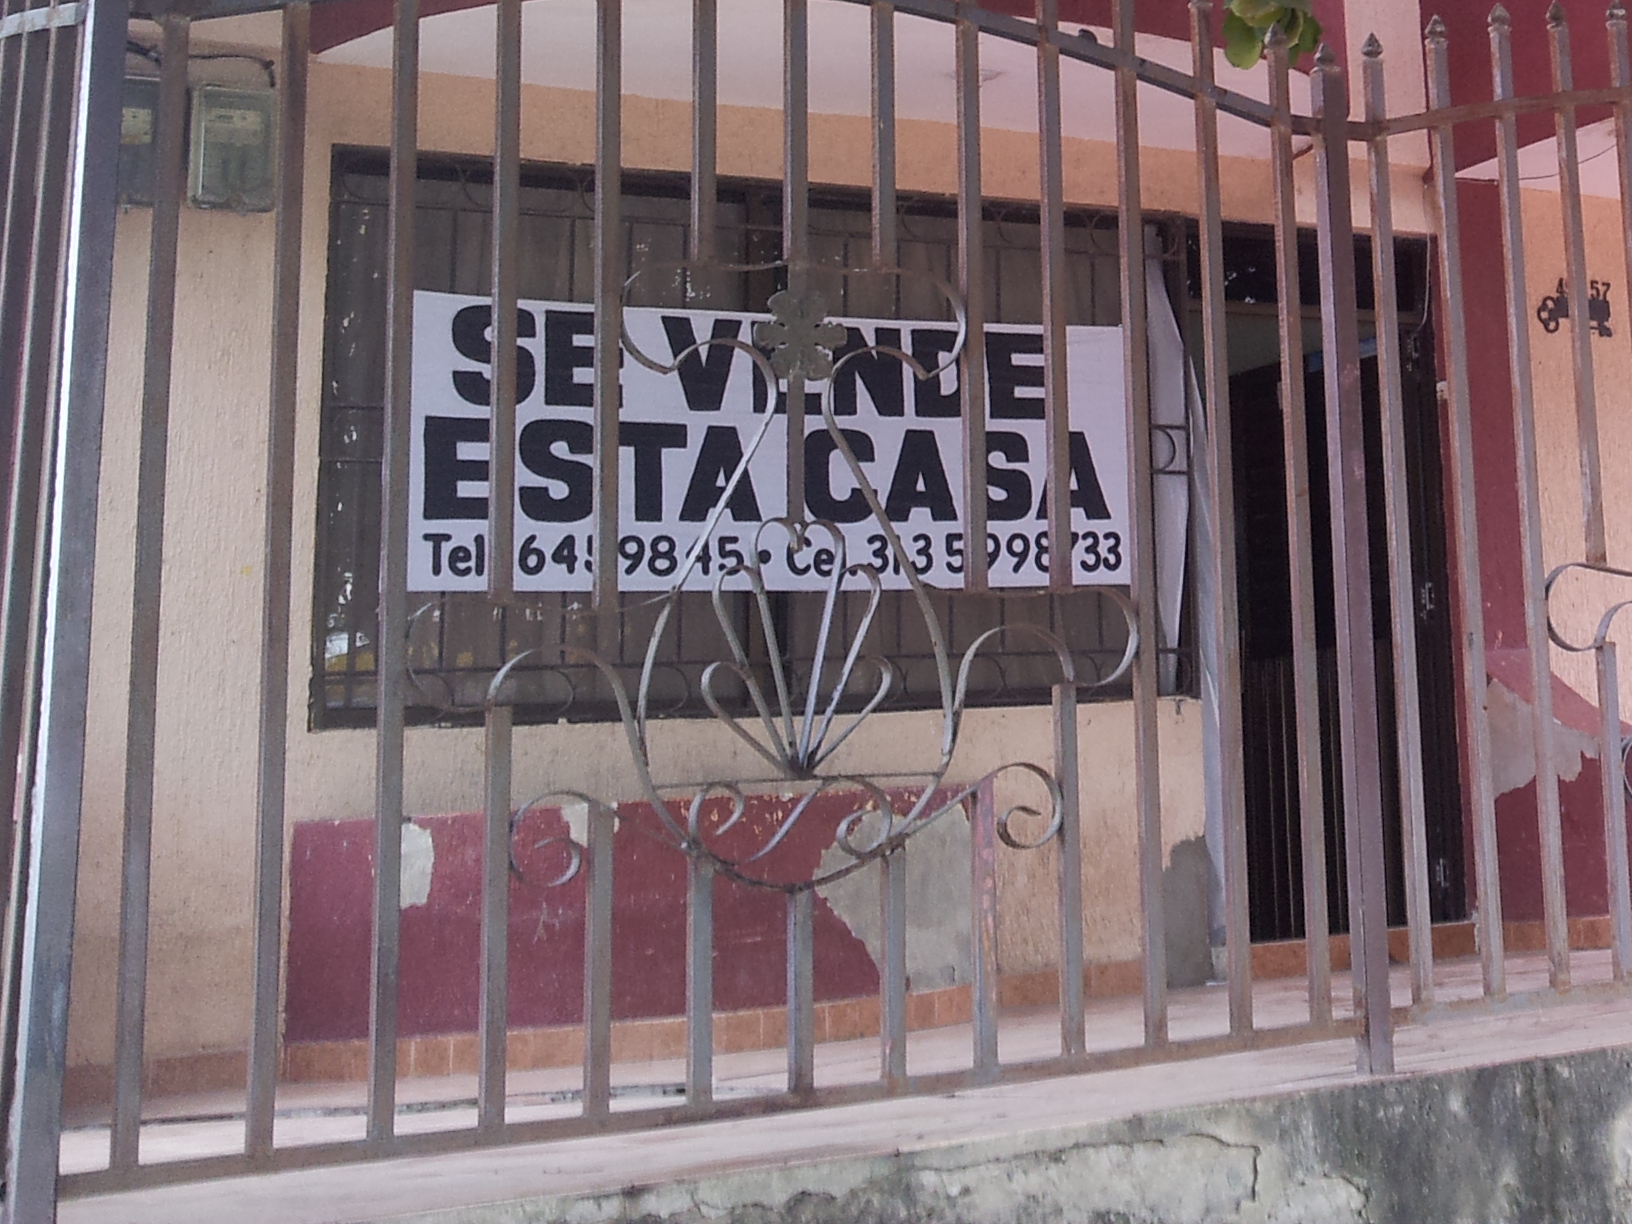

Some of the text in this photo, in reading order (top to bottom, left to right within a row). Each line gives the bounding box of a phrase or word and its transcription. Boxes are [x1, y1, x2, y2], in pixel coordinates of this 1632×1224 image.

[452, 304, 624, 409] SE
[423, 415, 1111, 522] ESTA CASA
